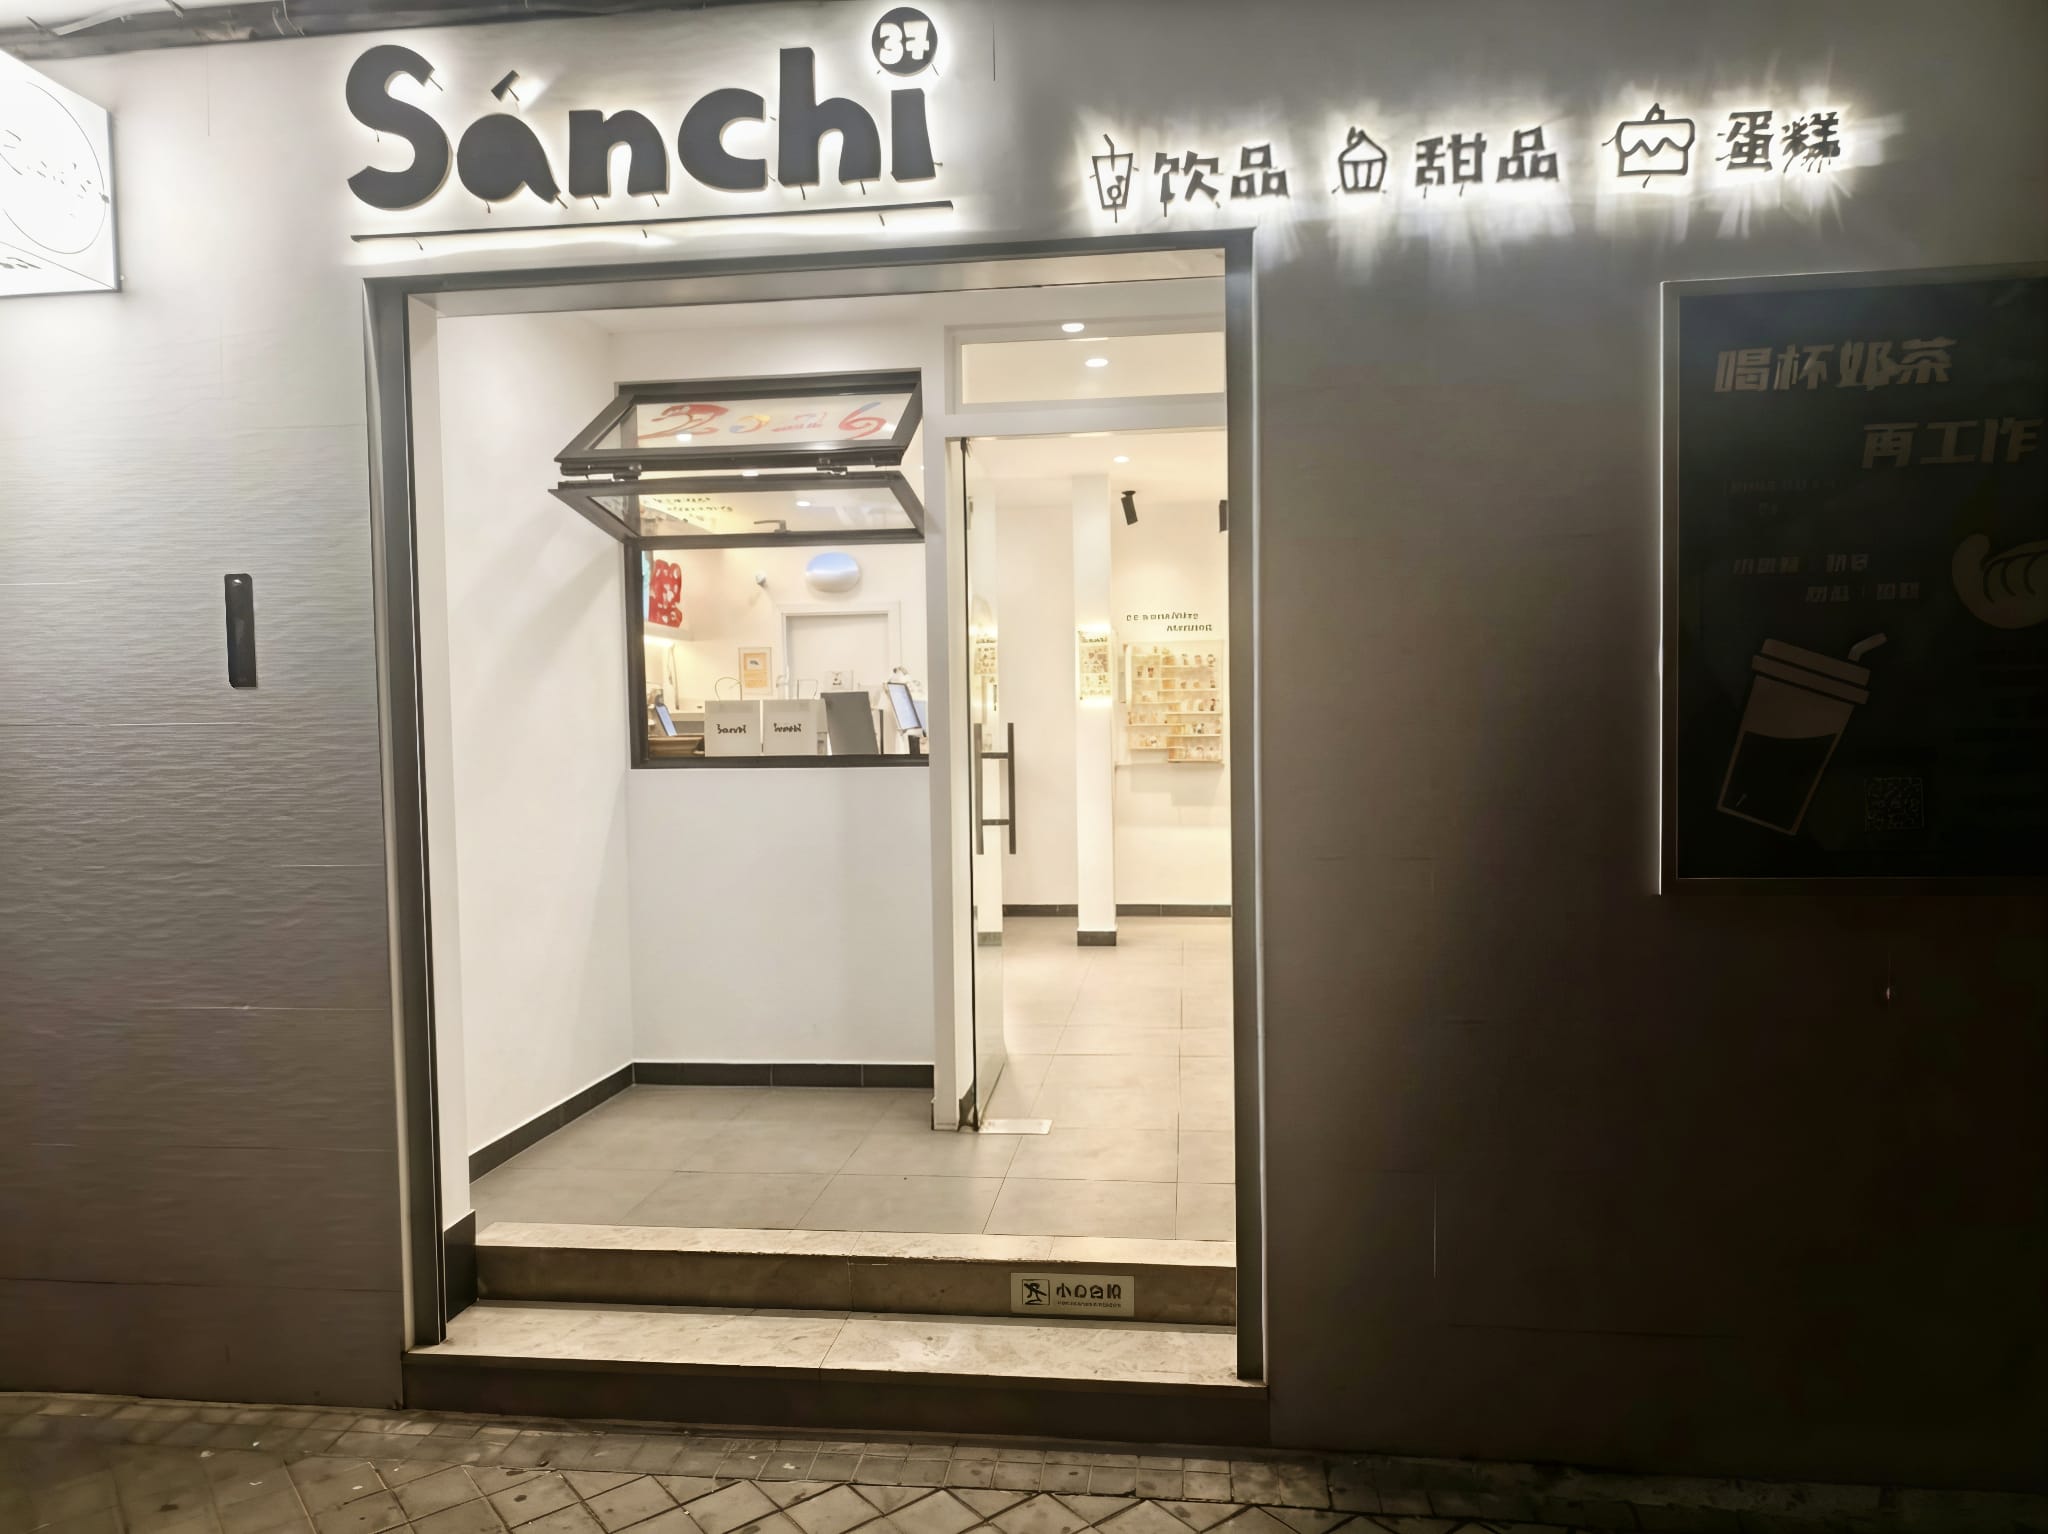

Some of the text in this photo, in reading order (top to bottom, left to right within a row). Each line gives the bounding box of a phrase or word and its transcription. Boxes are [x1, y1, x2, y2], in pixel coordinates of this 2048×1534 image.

[879, 21, 931, 64] 37
[345, 7, 938, 210] Sánchi
[1416, 125, 1560, 188] 甜品
[1725, 110, 1841, 173] 蛋糕
[1154, 143, 1289, 201] 饮品
[1714, 336, 1958, 392] 喝杯奶茶
[1861, 416, 2046, 468] 再工作
